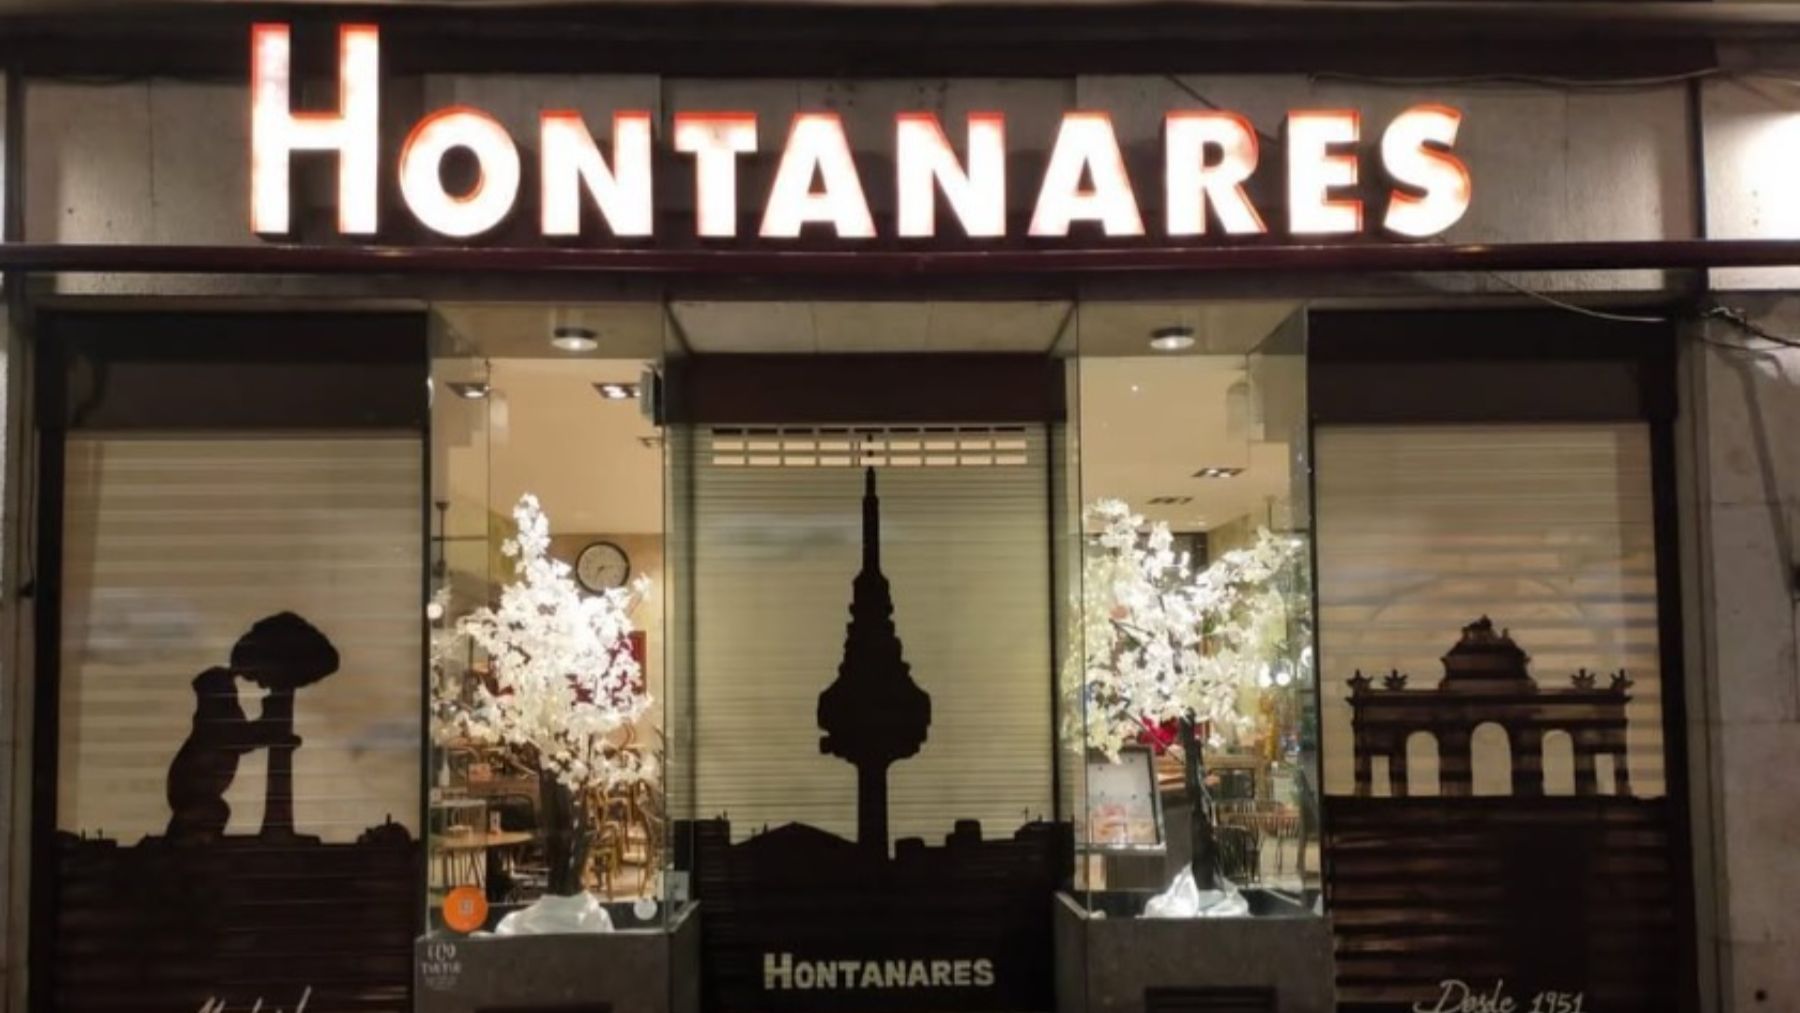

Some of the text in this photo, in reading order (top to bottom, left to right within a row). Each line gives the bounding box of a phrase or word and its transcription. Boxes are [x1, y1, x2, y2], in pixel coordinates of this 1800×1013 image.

[250, 23, 1472, 240] HONTANARES
[763, 952, 995, 990] HONTANARES
[1527, 990, 1586, 1013] 1951
